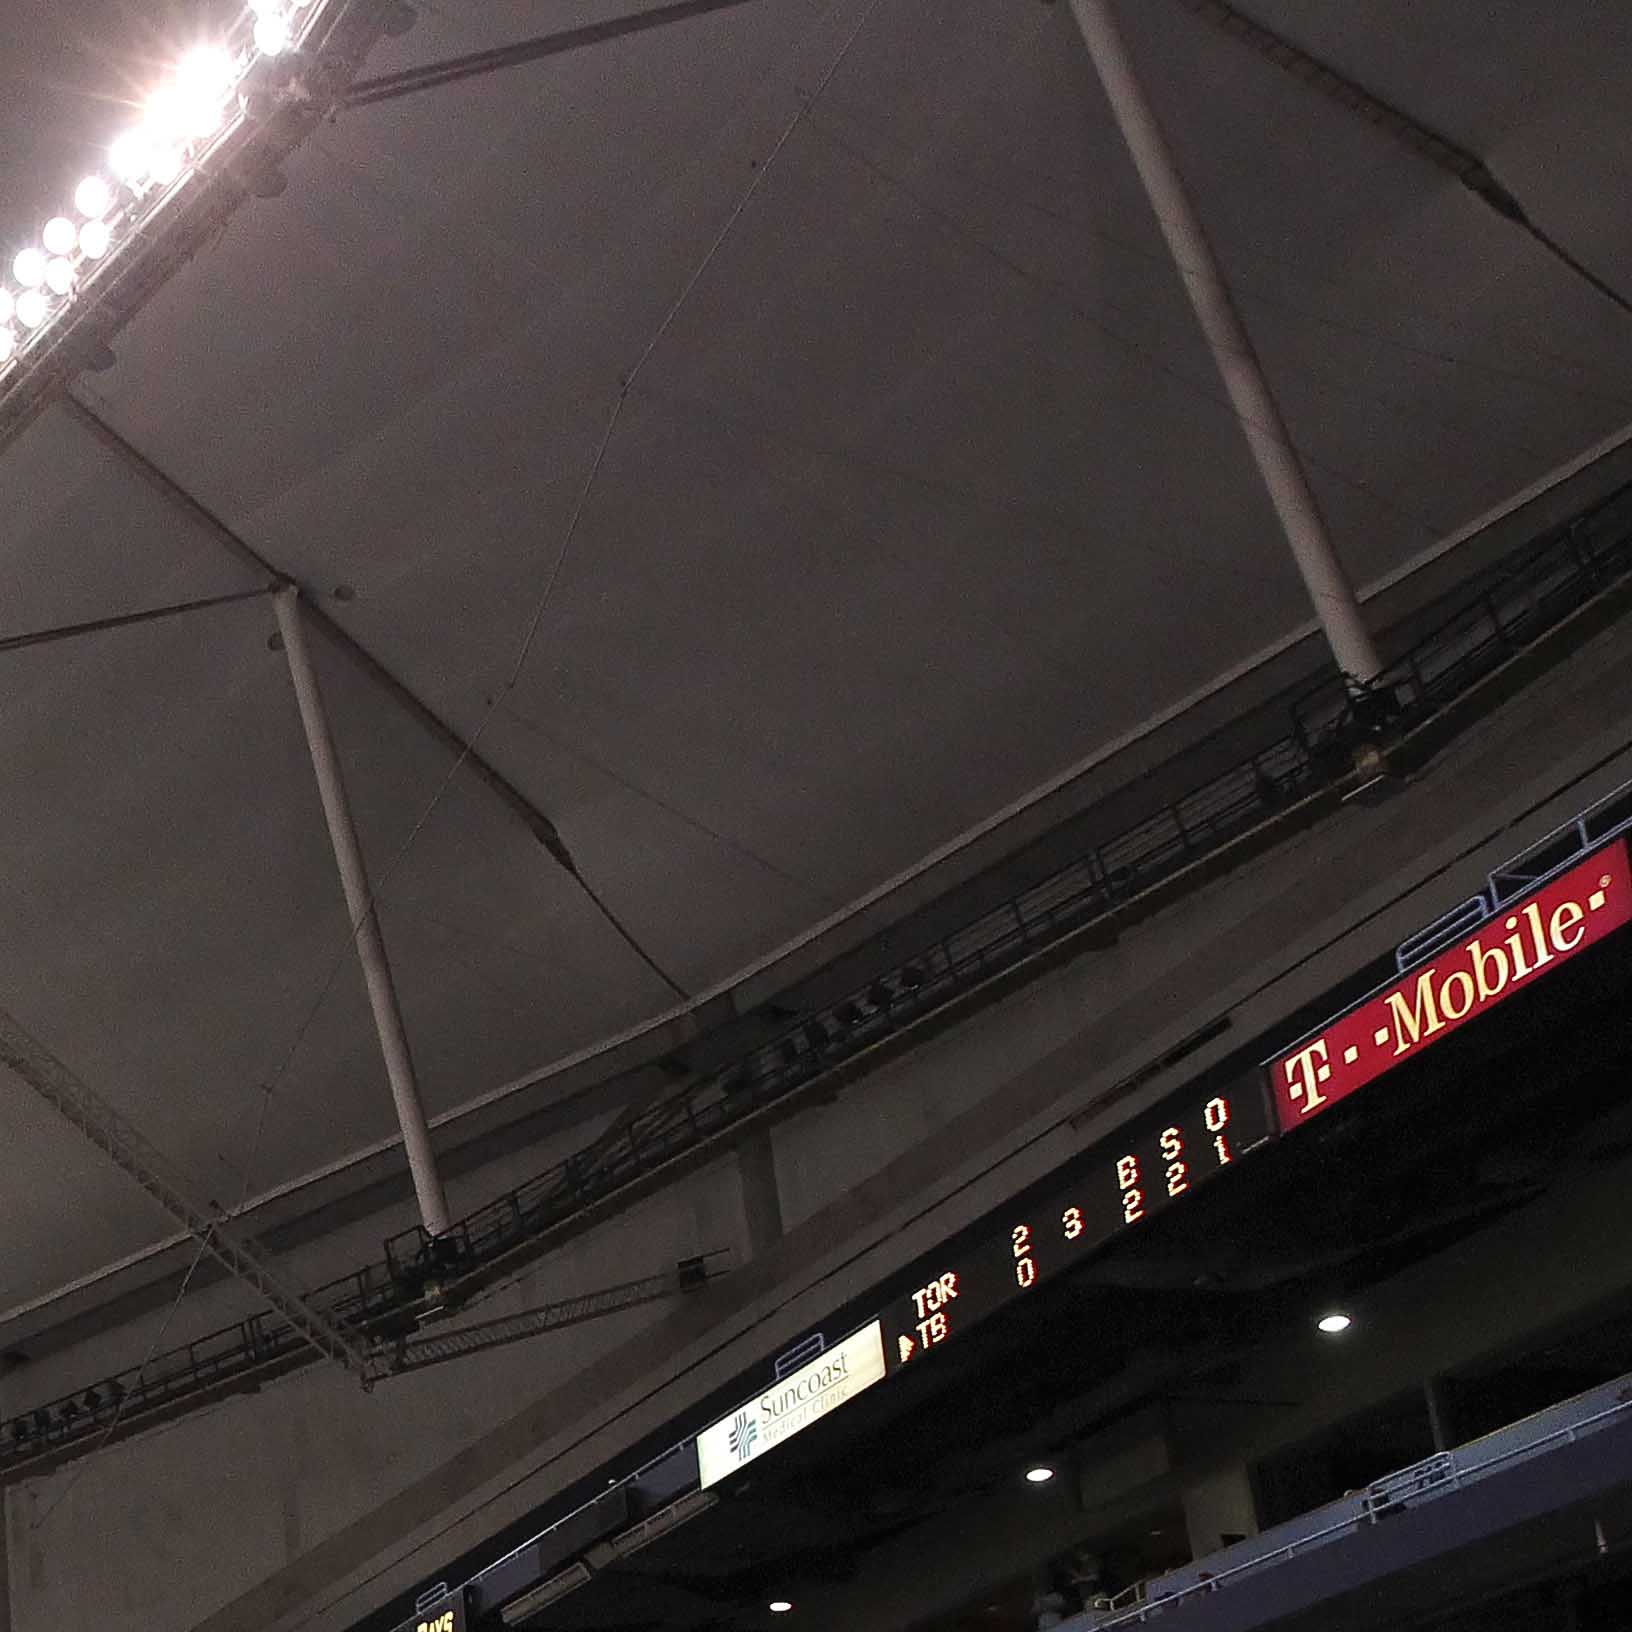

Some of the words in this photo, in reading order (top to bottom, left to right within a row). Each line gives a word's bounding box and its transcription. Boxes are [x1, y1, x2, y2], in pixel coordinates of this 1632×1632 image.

[1123, 1189, 1144, 1224] 2
[1165, 1162, 1189, 1197] 2
[1214, 1135, 1232, 1165] 1
[912, 1271, 958, 1318] TOR
[1012, 1225, 1031, 1257] 2
[1062, 1207, 1084, 1239] 3
[916, 1312, 949, 1349] TB
[760, 1351, 849, 1425] Suncoast
